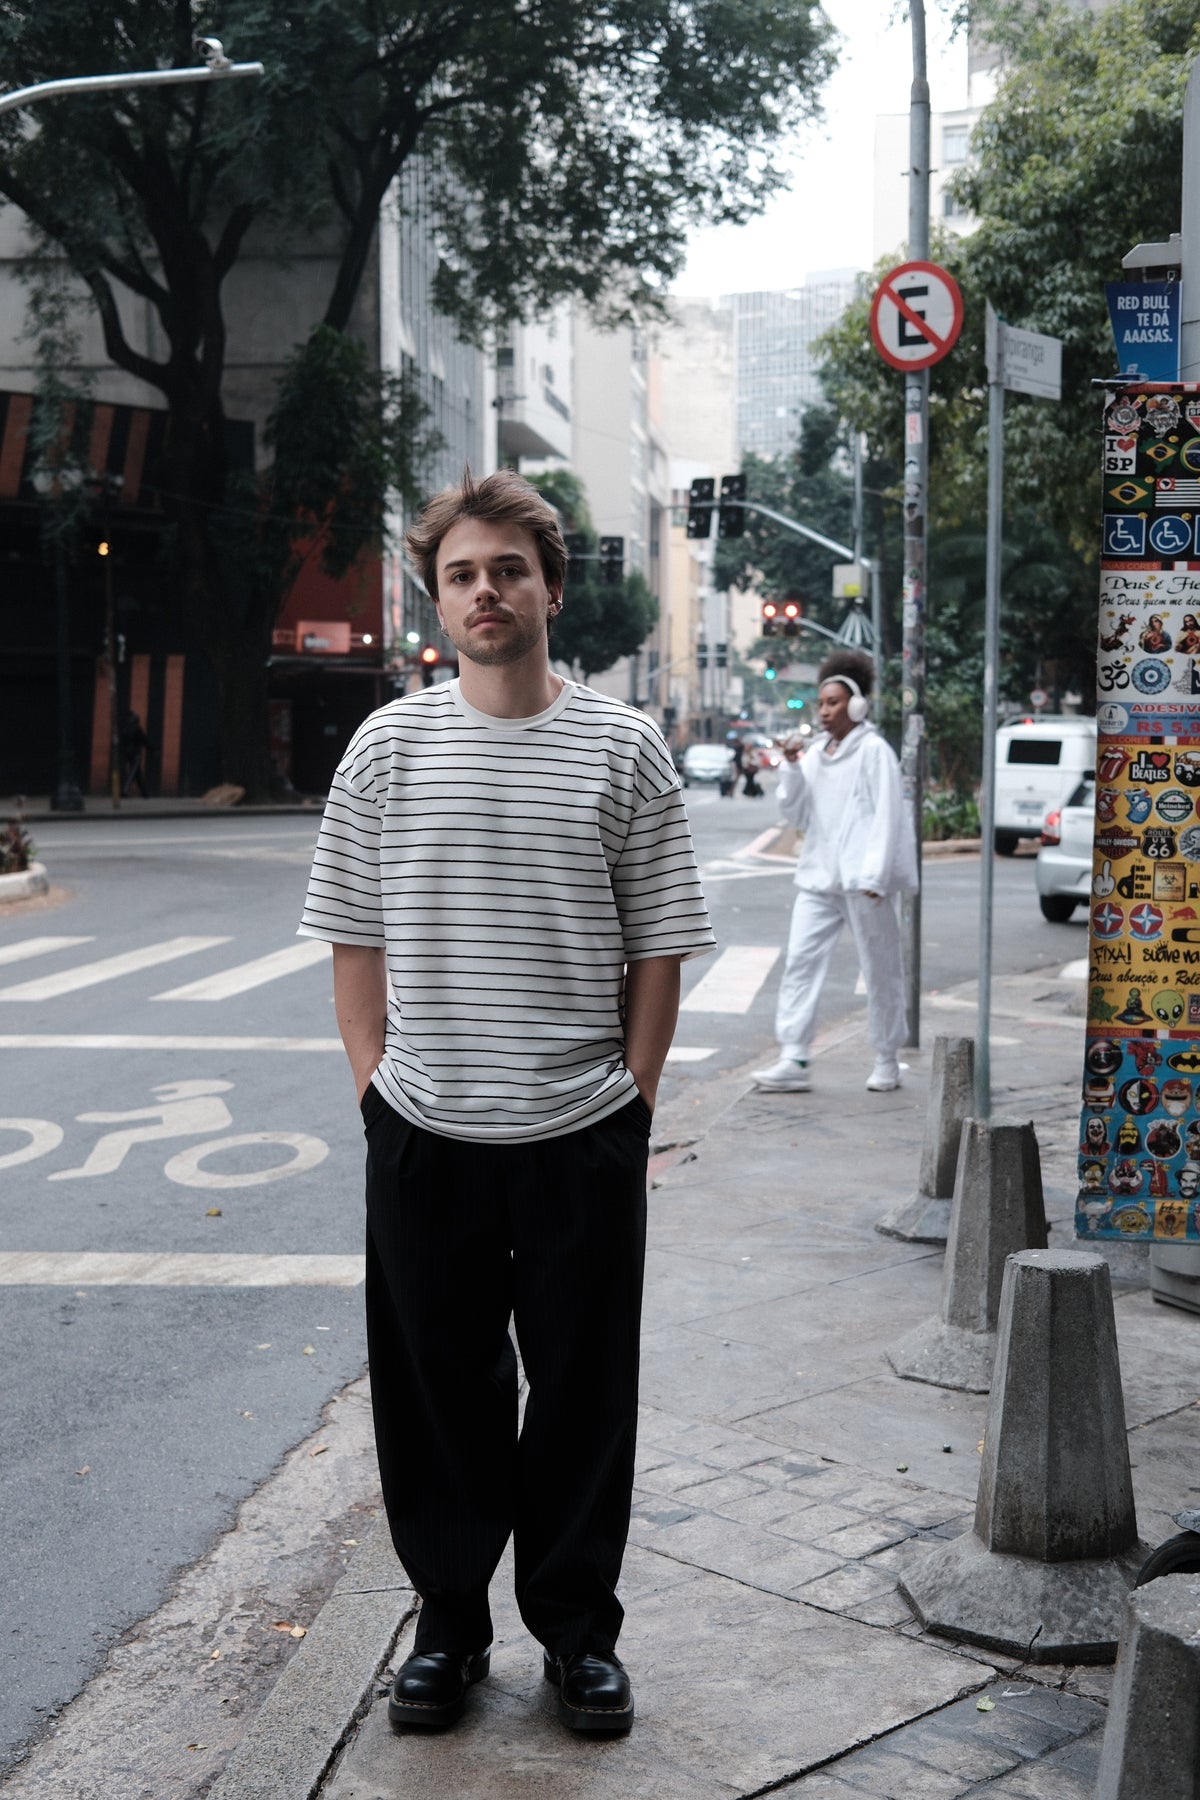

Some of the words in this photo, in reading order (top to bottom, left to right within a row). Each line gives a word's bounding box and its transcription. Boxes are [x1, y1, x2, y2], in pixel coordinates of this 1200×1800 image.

[1117, 296, 1140, 310] RED
[1142, 295, 1170, 309] BULL
[1136, 312, 1150, 327] TE
[1152, 309, 1170, 326] DÁ
[1123, 329, 1173, 343] AAASAS.
[1106, 439, 1117, 452] I
[1106, 457, 1133, 471] SP
[1126, 562, 1159, 570] CORES
[1105, 576, 1150, 590] Deus
[1154, 579, 1165, 590] é
[1117, 593, 1140, 606] Deus
[1143, 598, 1167, 609] quem
[1130, 704, 1200, 713] ADESIV
[1136, 720, 1164, 734] R$
[1140, 753, 1146, 769] I
[1132, 764, 1168, 781] BEATLES
[1148, 844, 1170, 857] 66
[1142, 946, 1180, 963] suave
[1090, 967, 1113, 982] Deus
